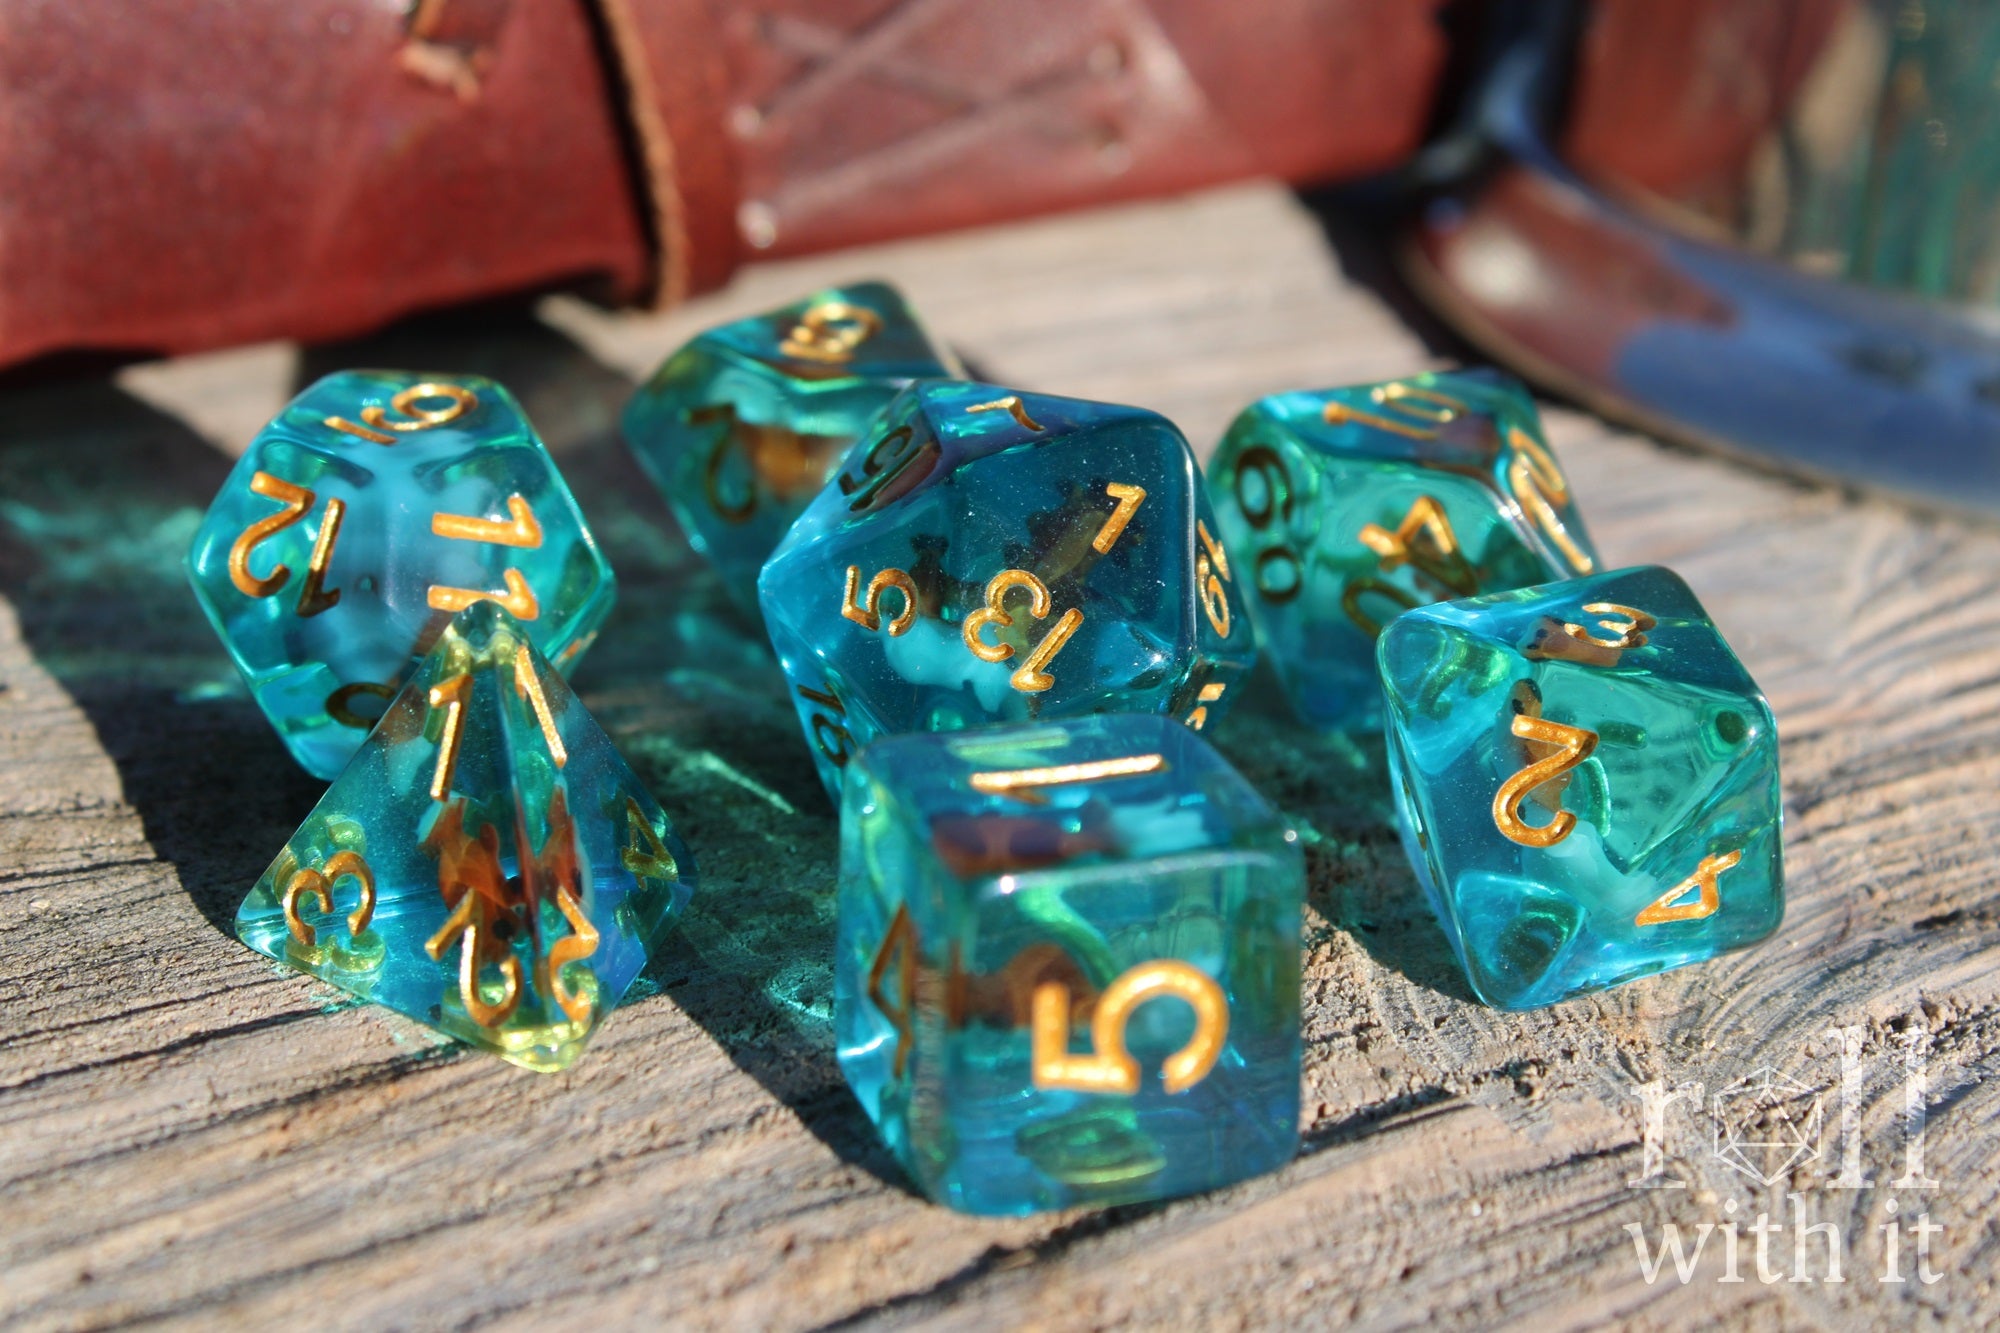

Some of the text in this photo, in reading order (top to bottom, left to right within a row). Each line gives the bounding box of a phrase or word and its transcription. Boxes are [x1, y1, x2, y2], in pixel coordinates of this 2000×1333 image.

[229, 471, 346, 618] 12
[427, 492, 542, 621] 11
[841, 565, 918, 637] 5
[963, 569, 1084, 693] 13
[428, 674, 474, 802] 1
[970, 753, 1171, 805] 1
[1492, 714, 1599, 848] 2
[283, 850, 376, 946] 3
[1635, 848, 1742, 928] 4
[548, 885, 599, 1023] 2
[1031, 958, 1231, 1095] 5
